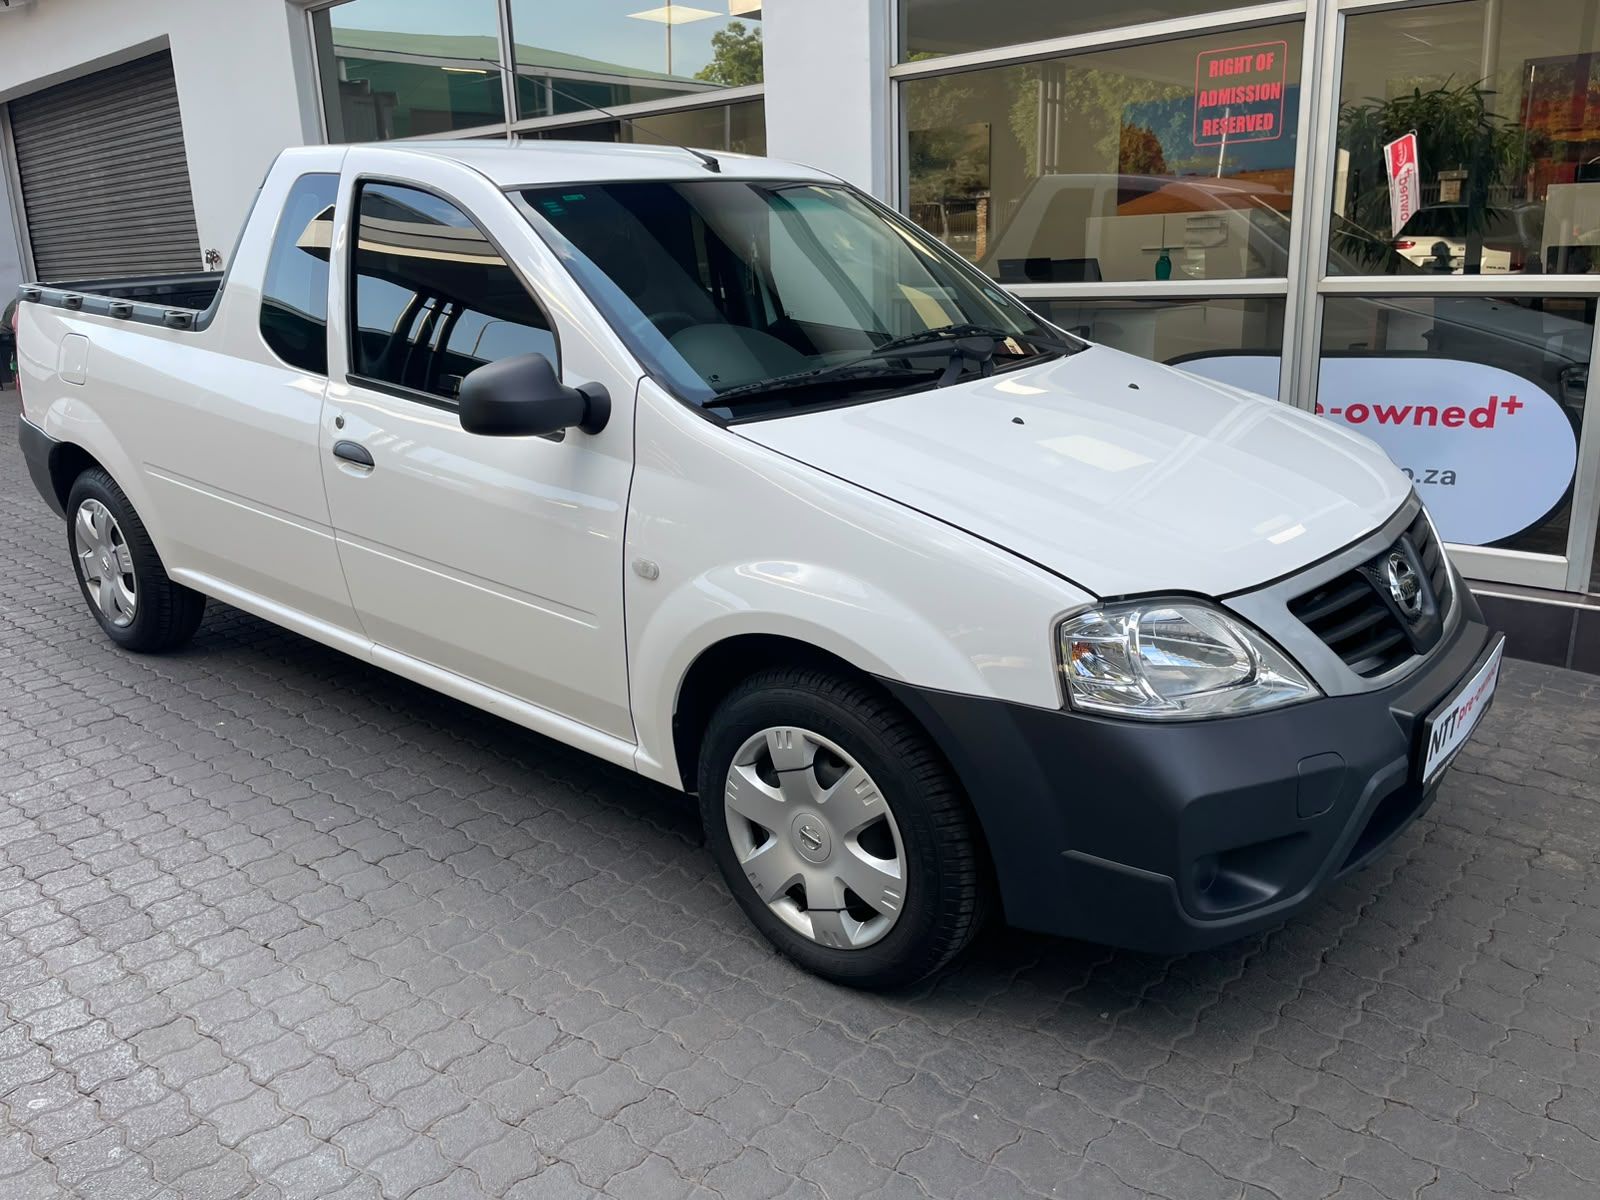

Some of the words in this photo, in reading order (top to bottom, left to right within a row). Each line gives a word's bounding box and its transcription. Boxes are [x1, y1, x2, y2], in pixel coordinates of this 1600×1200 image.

[1209, 55, 1253, 78] RIGHT
[1256, 52, 1274, 71] OF
[1200, 82, 1280, 108] ADMISSION
[1202, 113, 1273, 137] RESERVED
[1429, 706, 1459, 762] NTT
